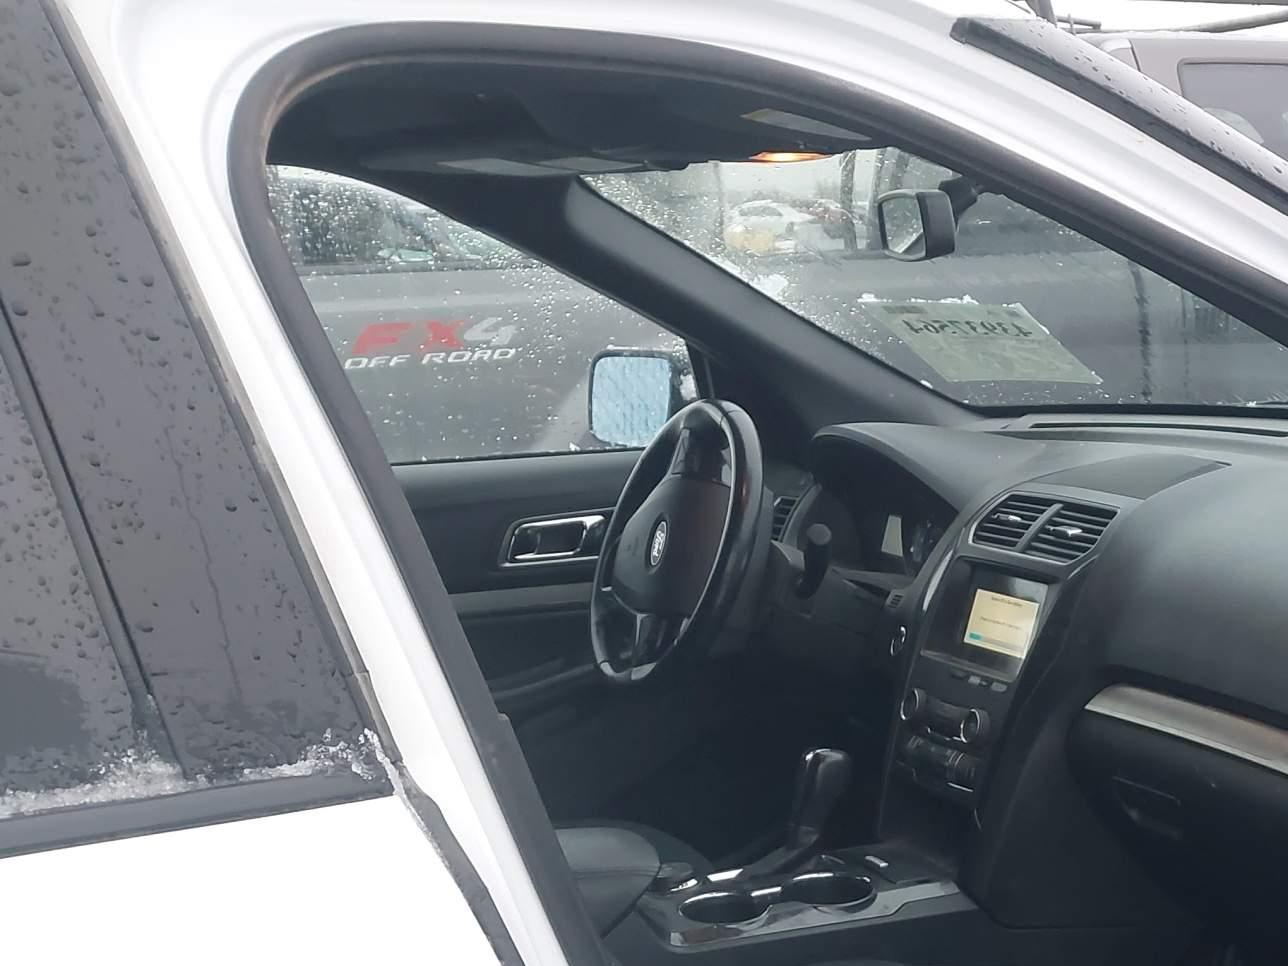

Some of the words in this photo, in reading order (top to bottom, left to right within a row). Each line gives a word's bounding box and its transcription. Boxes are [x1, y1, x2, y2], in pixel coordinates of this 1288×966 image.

[352, 317, 517, 355] FX4
[344, 354, 411, 369] OFF
[421, 349, 516, 364] ROAD
